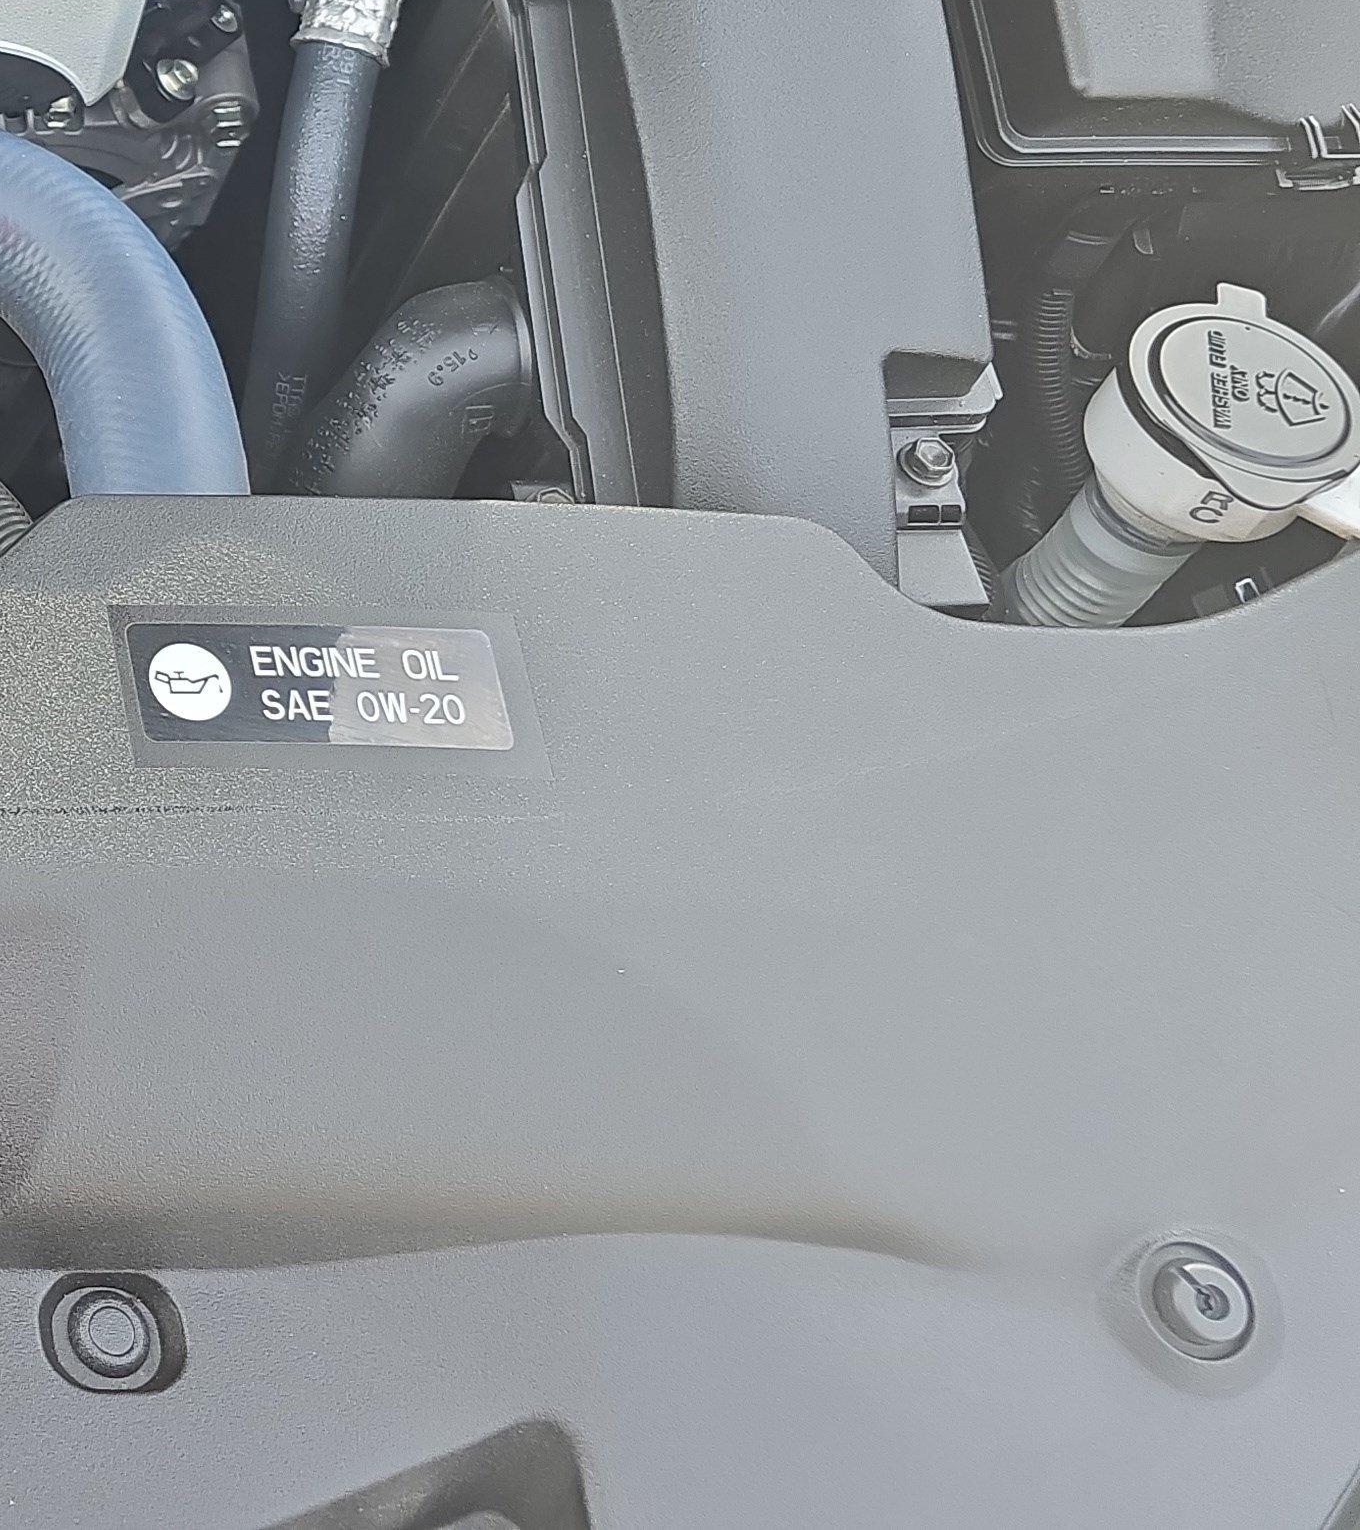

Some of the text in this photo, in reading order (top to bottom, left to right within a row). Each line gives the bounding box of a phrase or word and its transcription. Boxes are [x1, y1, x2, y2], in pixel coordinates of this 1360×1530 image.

[1207, 329, 1231, 430] WASHER FLUID
[1230, 364, 1250, 403] ONLY
[248, 644, 460, 682] ENGINE OIL
[261, 689, 467, 725] SAE 0W-20
